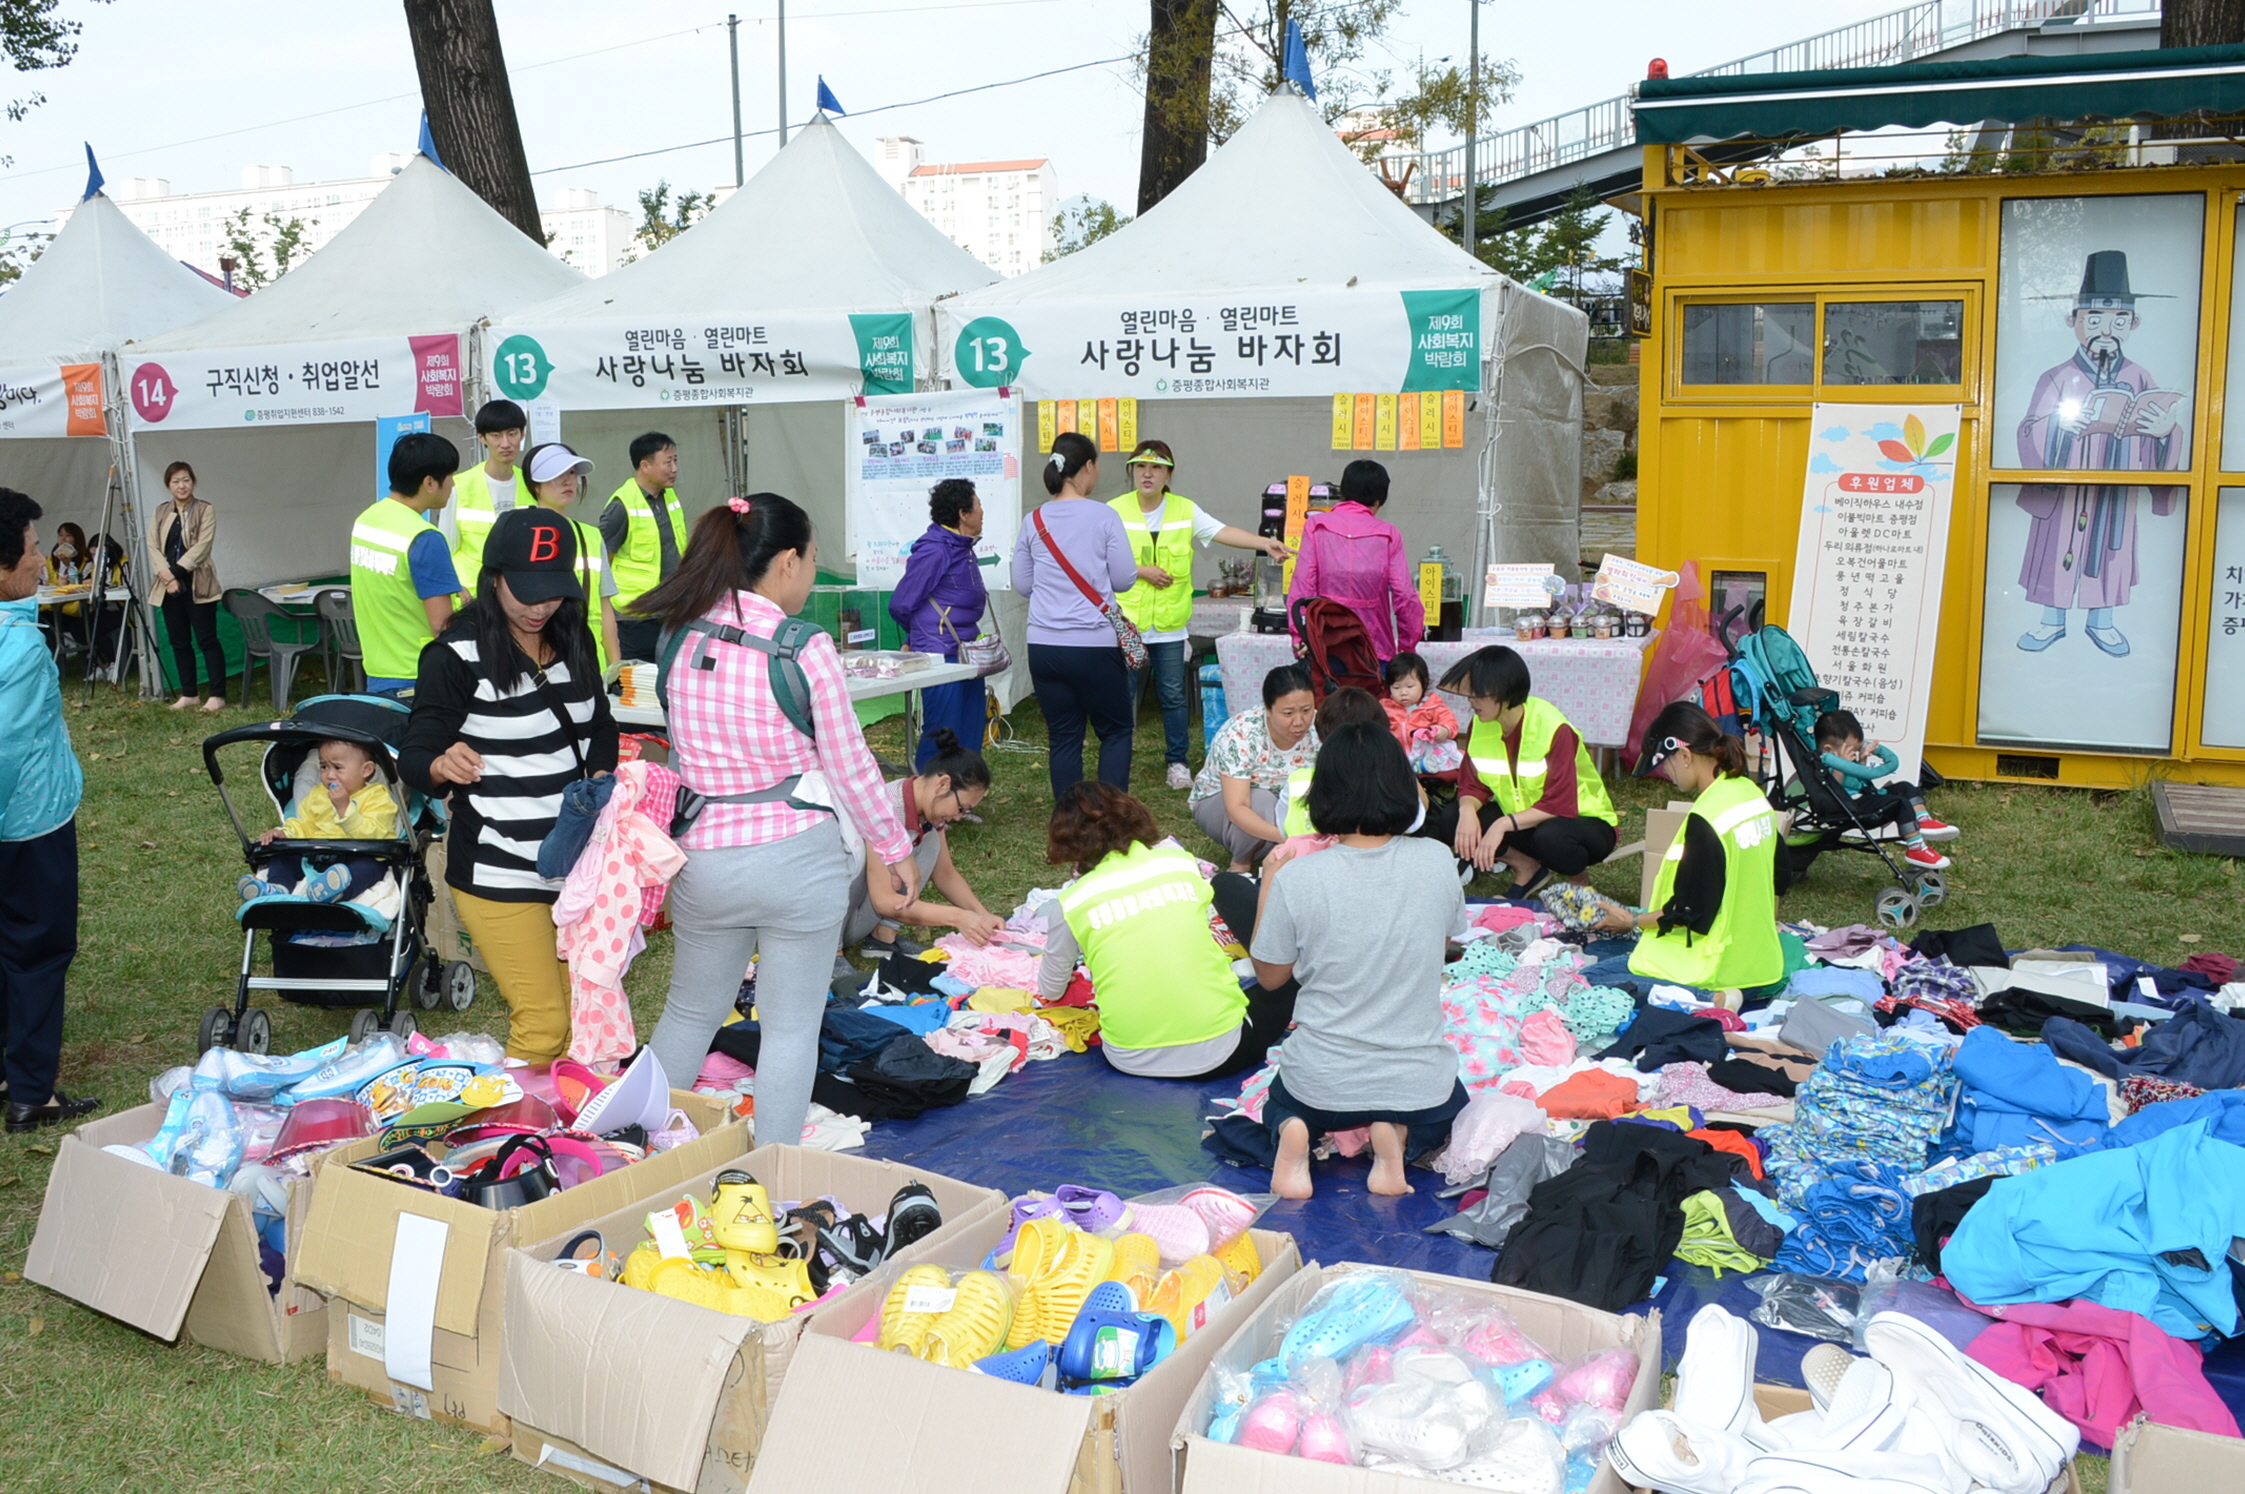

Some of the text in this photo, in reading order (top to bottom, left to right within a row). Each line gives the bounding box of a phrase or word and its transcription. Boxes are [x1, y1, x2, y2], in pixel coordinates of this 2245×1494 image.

[1120, 306, 1299, 335] 열린마음 열린마트
[1428, 314, 1463, 331] 제9회
[624, 326, 769, 351] 열린마음 열린마트
[1418, 331, 1474, 350] 사회복지
[426, 354, 449, 367] 제9회
[969, 337, 1008, 372] 13
[1080, 331, 1343, 376] 사랑나눔 바자회
[1424, 350, 1467, 368] 박람회
[206, 359, 380, 397] 구직신청 취업알선
[420, 368, 456, 383] 사회복지
[503, 353, 537, 385] 13
[595, 350, 809, 389] 사랑나눔 바자회
[138, 378, 166, 407] 14
[425, 384, 453, 397] 박람회
[672, 386, 754, 402] 증평종합사회복지관
[1171, 378, 1270, 394] 증평종합사회복지관
[257, 406, 345, 421] 증평취업지원센터 838-1542
[1103, 400, 1112, 436] 슬러시
[1122, 400, 1132, 439] 아이스티
[1338, 395, 1347, 433] 슬러시
[1360, 396, 1369, 437] 아이스티
[1381, 395, 1391, 434] 슬러시
[1404, 396, 1414, 437] 아이스티
[1426, 393, 1435, 432] 슬러시
[1449, 393, 1458, 435] 아이스티
[1849, 475, 1915, 491] 후원업체
[1292, 478, 1304, 520] 슬러시
[1834, 497, 1923, 511] 베이직하우스 내수점
[1889, 514, 1917, 525] 증평점
[529, 526, 562, 562] B
[1835, 556, 1908, 570] 오복건어물마트
[2225, 566, 2245, 584] 치
[1425, 566, 1436, 614] 아이스티
[2224, 592, 2245, 609] 가
[1835, 630, 1890, 644] 세림칼국수
[1831, 645, 1891, 659] 전통손칼국수
[1832, 660, 1887, 674] 서울화원
[1858, 692, 1886, 704] 커피숍
[1870, 708, 1898, 721] 커피숍
